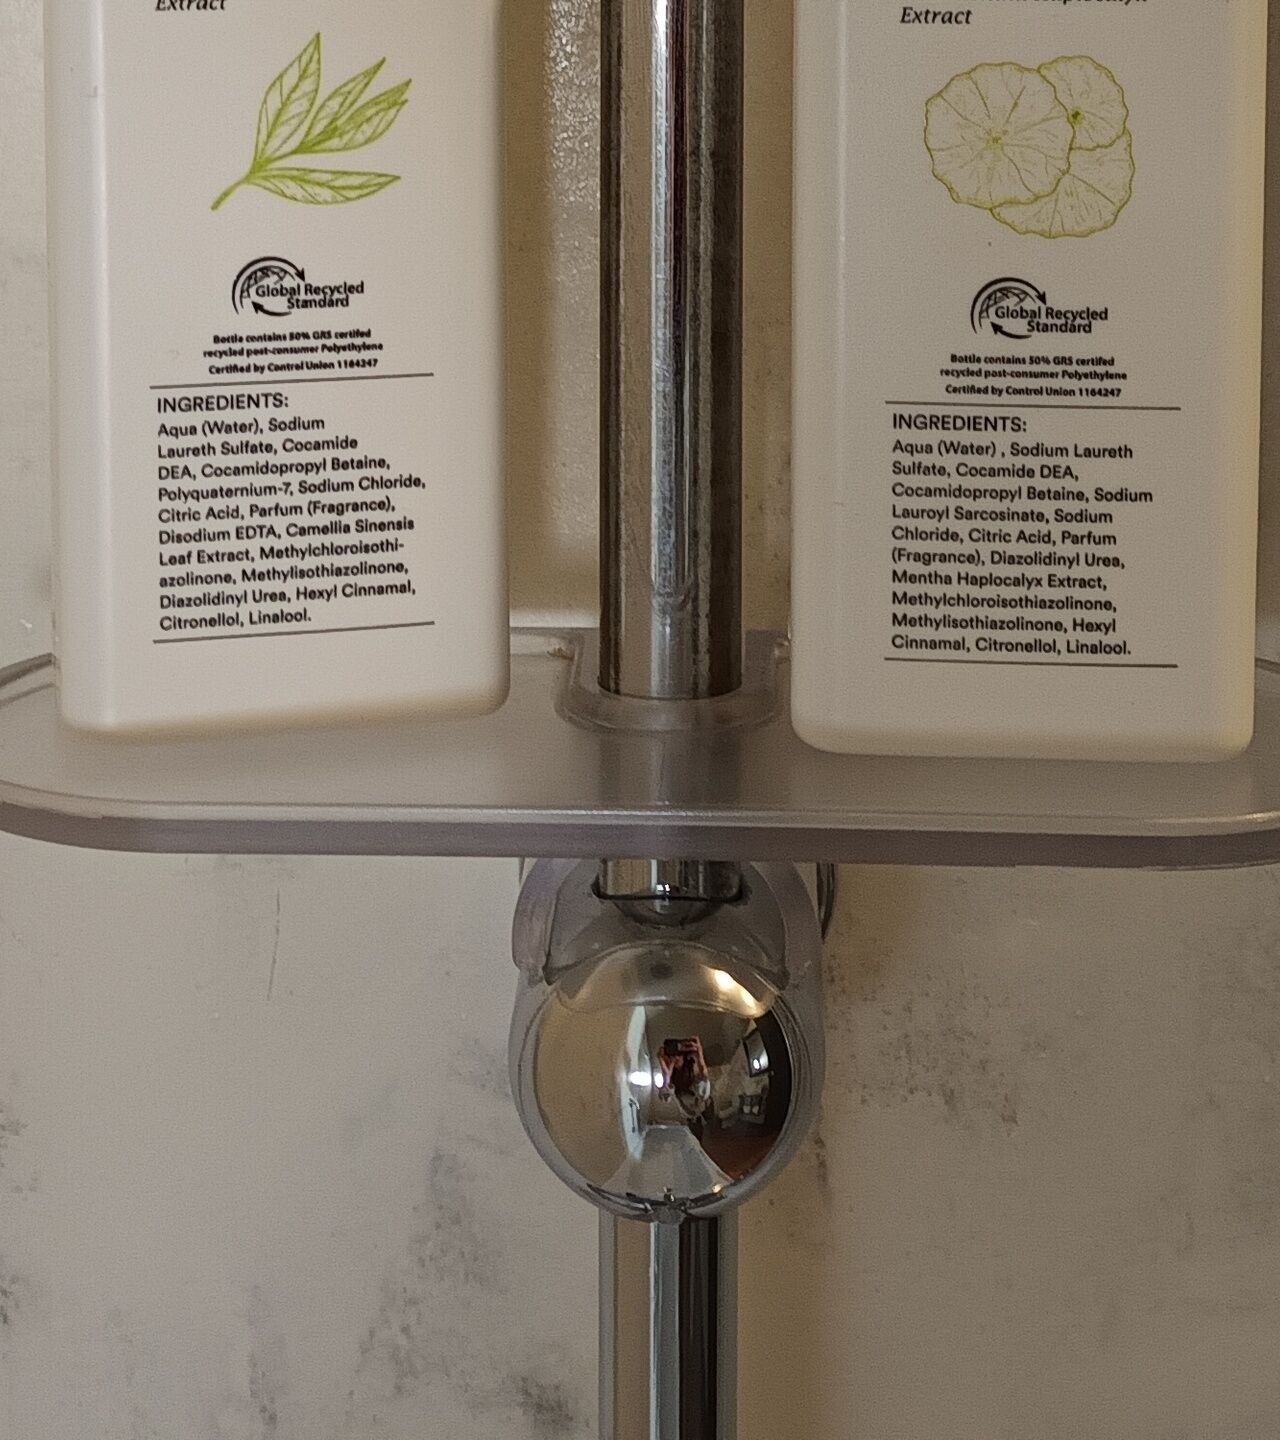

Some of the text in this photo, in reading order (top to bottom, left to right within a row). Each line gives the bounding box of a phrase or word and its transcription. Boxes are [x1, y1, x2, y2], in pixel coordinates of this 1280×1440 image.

[900, 7, 972, 24] Extract
[256, 281, 364, 304] Global Recycled
[287, 295, 349, 310] Standard
[995, 306, 1108, 324] Global Recycled
[1027, 321, 1092, 334] Standard
[203, 341, 383, 359] recycled post-consumer Polyethylene
[950, 353, 982, 364] Bottle
[983, 355, 1026, 365] contains
[1029, 355, 1051, 365] 50%
[1052, 356, 1073, 366] GRS
[253, 363, 265, 374] by
[267, 361, 304, 372] Control
[305, 360, 335, 370] Union
[940, 367, 1127, 382] recycled post-consumer Polyethylene
[991, 385, 1004, 397] by
[1005, 386, 1043, 396] Control
[1045, 386, 1076, 397] Union
[1079, 387, 1122, 397] 1164247
[158, 392, 288, 413] INGREDIENTS:
[158, 416, 325, 439] Aqua (Water), Sodium
[893, 413, 1026, 432] INGREDIENTS:
[158, 435, 358, 459] Laureth Sulfate, Cocamide
[892, 439, 933, 457] Aqua
[938, 440, 996, 458] (Water)
[1010, 442, 1069, 457] Sodium
[1074, 443, 1133, 459] Laureth
[158, 455, 390, 481] DEA, Cocamidopropyl Betaine,
[892, 460, 1079, 482] Sulfate, Cocamide DEA,
[158, 474, 426, 504] Polyquaternium-7, Sodium Chloride,
[892, 482, 1153, 503] Cocamidopropyl Betaine, Sodium
[158, 495, 395, 523] Citric Acid, Parfum (Fragrance),
[892, 504, 1113, 525] Lauroyl Sarcosinate, Sodium
[159, 516, 414, 545] Disodium EDTA, Camellia Sinensis
[891, 525, 1117, 547] Chloride, Citric Acid, Parfum
[159, 537, 404, 566] Leaf Extract, Methylchloroisothi-
[892, 546, 1125, 570] (Fragrance), Diazolidinyl Urea,
[159, 561, 408, 588] azolinone, Methylisothiazolinone,
[892, 569, 1107, 591] Mentha Haplocalyx Extract,
[160, 579, 416, 609] Diazolidinyl Urea, Hexyl Cinnamal,
[892, 591, 1117, 613] Methylchloroisothiazolinone,
[160, 607, 311, 631] Citronellol, Linalool.
[892, 612, 1116, 636] Methylisothiazolinone, Hexyl
[891, 634, 1131, 655] Cinnamal, Citronellol, Linalool.
